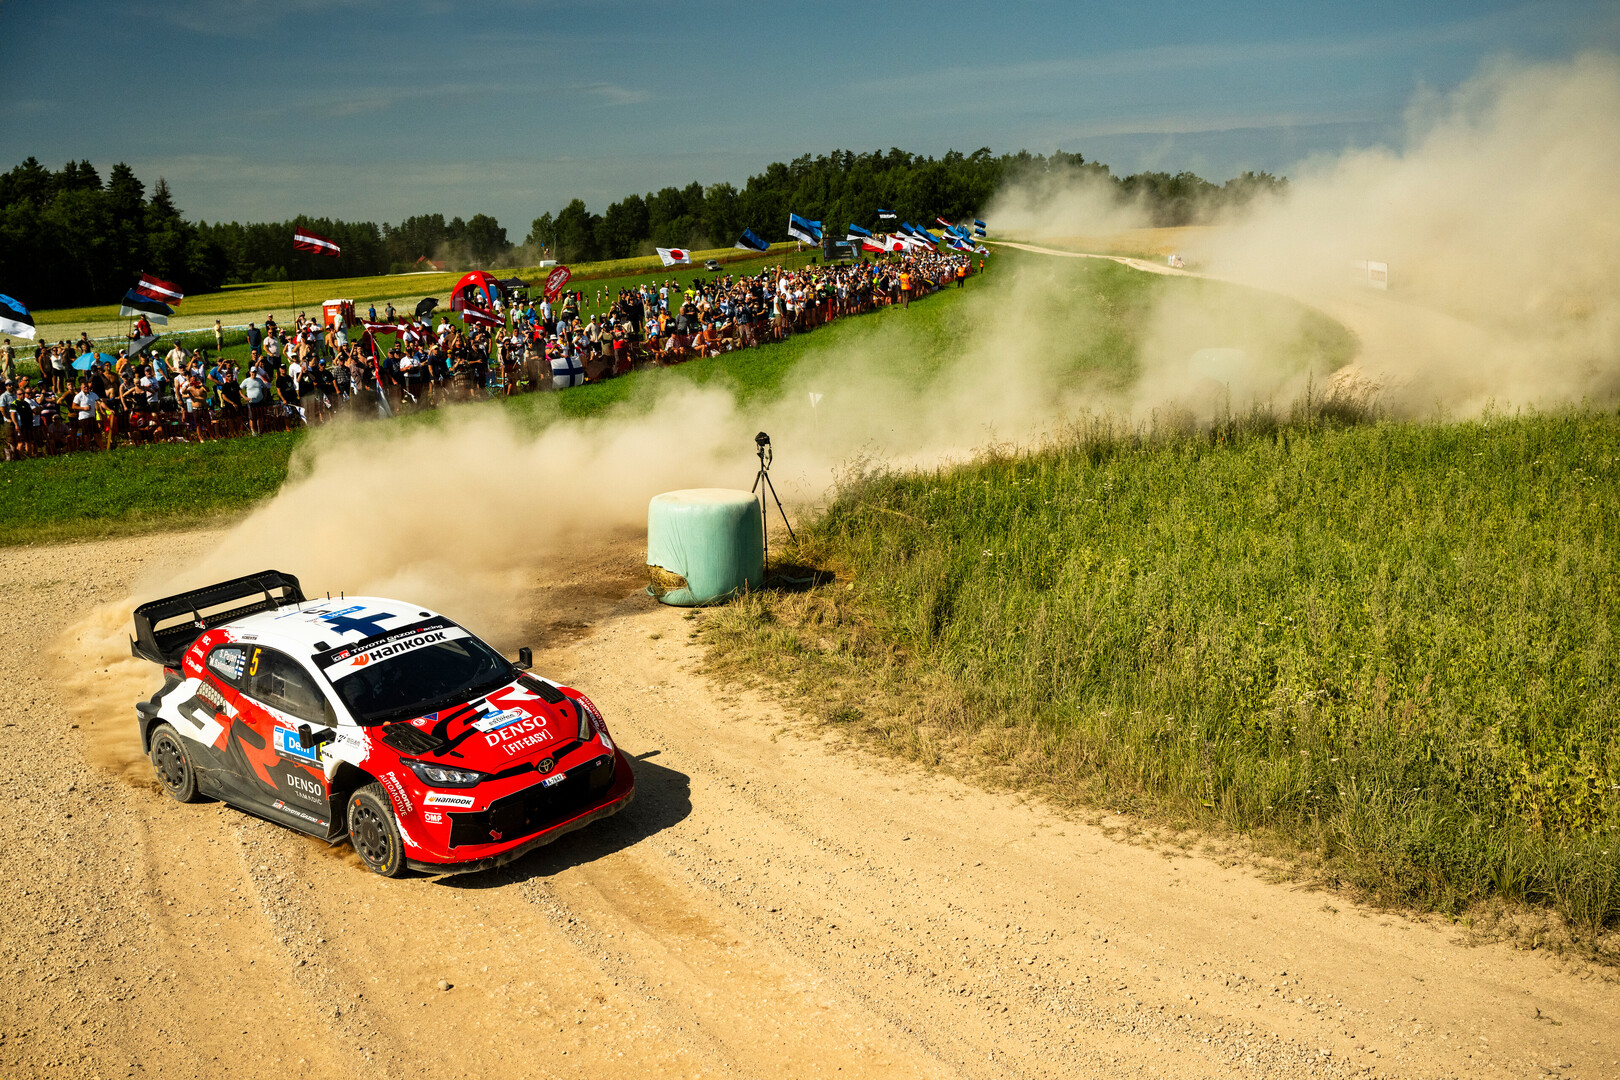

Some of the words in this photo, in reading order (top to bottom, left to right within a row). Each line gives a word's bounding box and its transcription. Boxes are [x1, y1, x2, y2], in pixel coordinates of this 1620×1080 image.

[351, 638, 386, 654] TOYOTA
[386, 630, 416, 643] GAZOO
[250, 648, 262, 677] 5
[485, 715, 547, 747] DENSO
[286, 773, 322, 797] DENSO
[378, 775, 408, 817] AUTOMOTIVE
[386, 771, 414, 813] Panasonic
[424, 812, 442, 823] OMP
